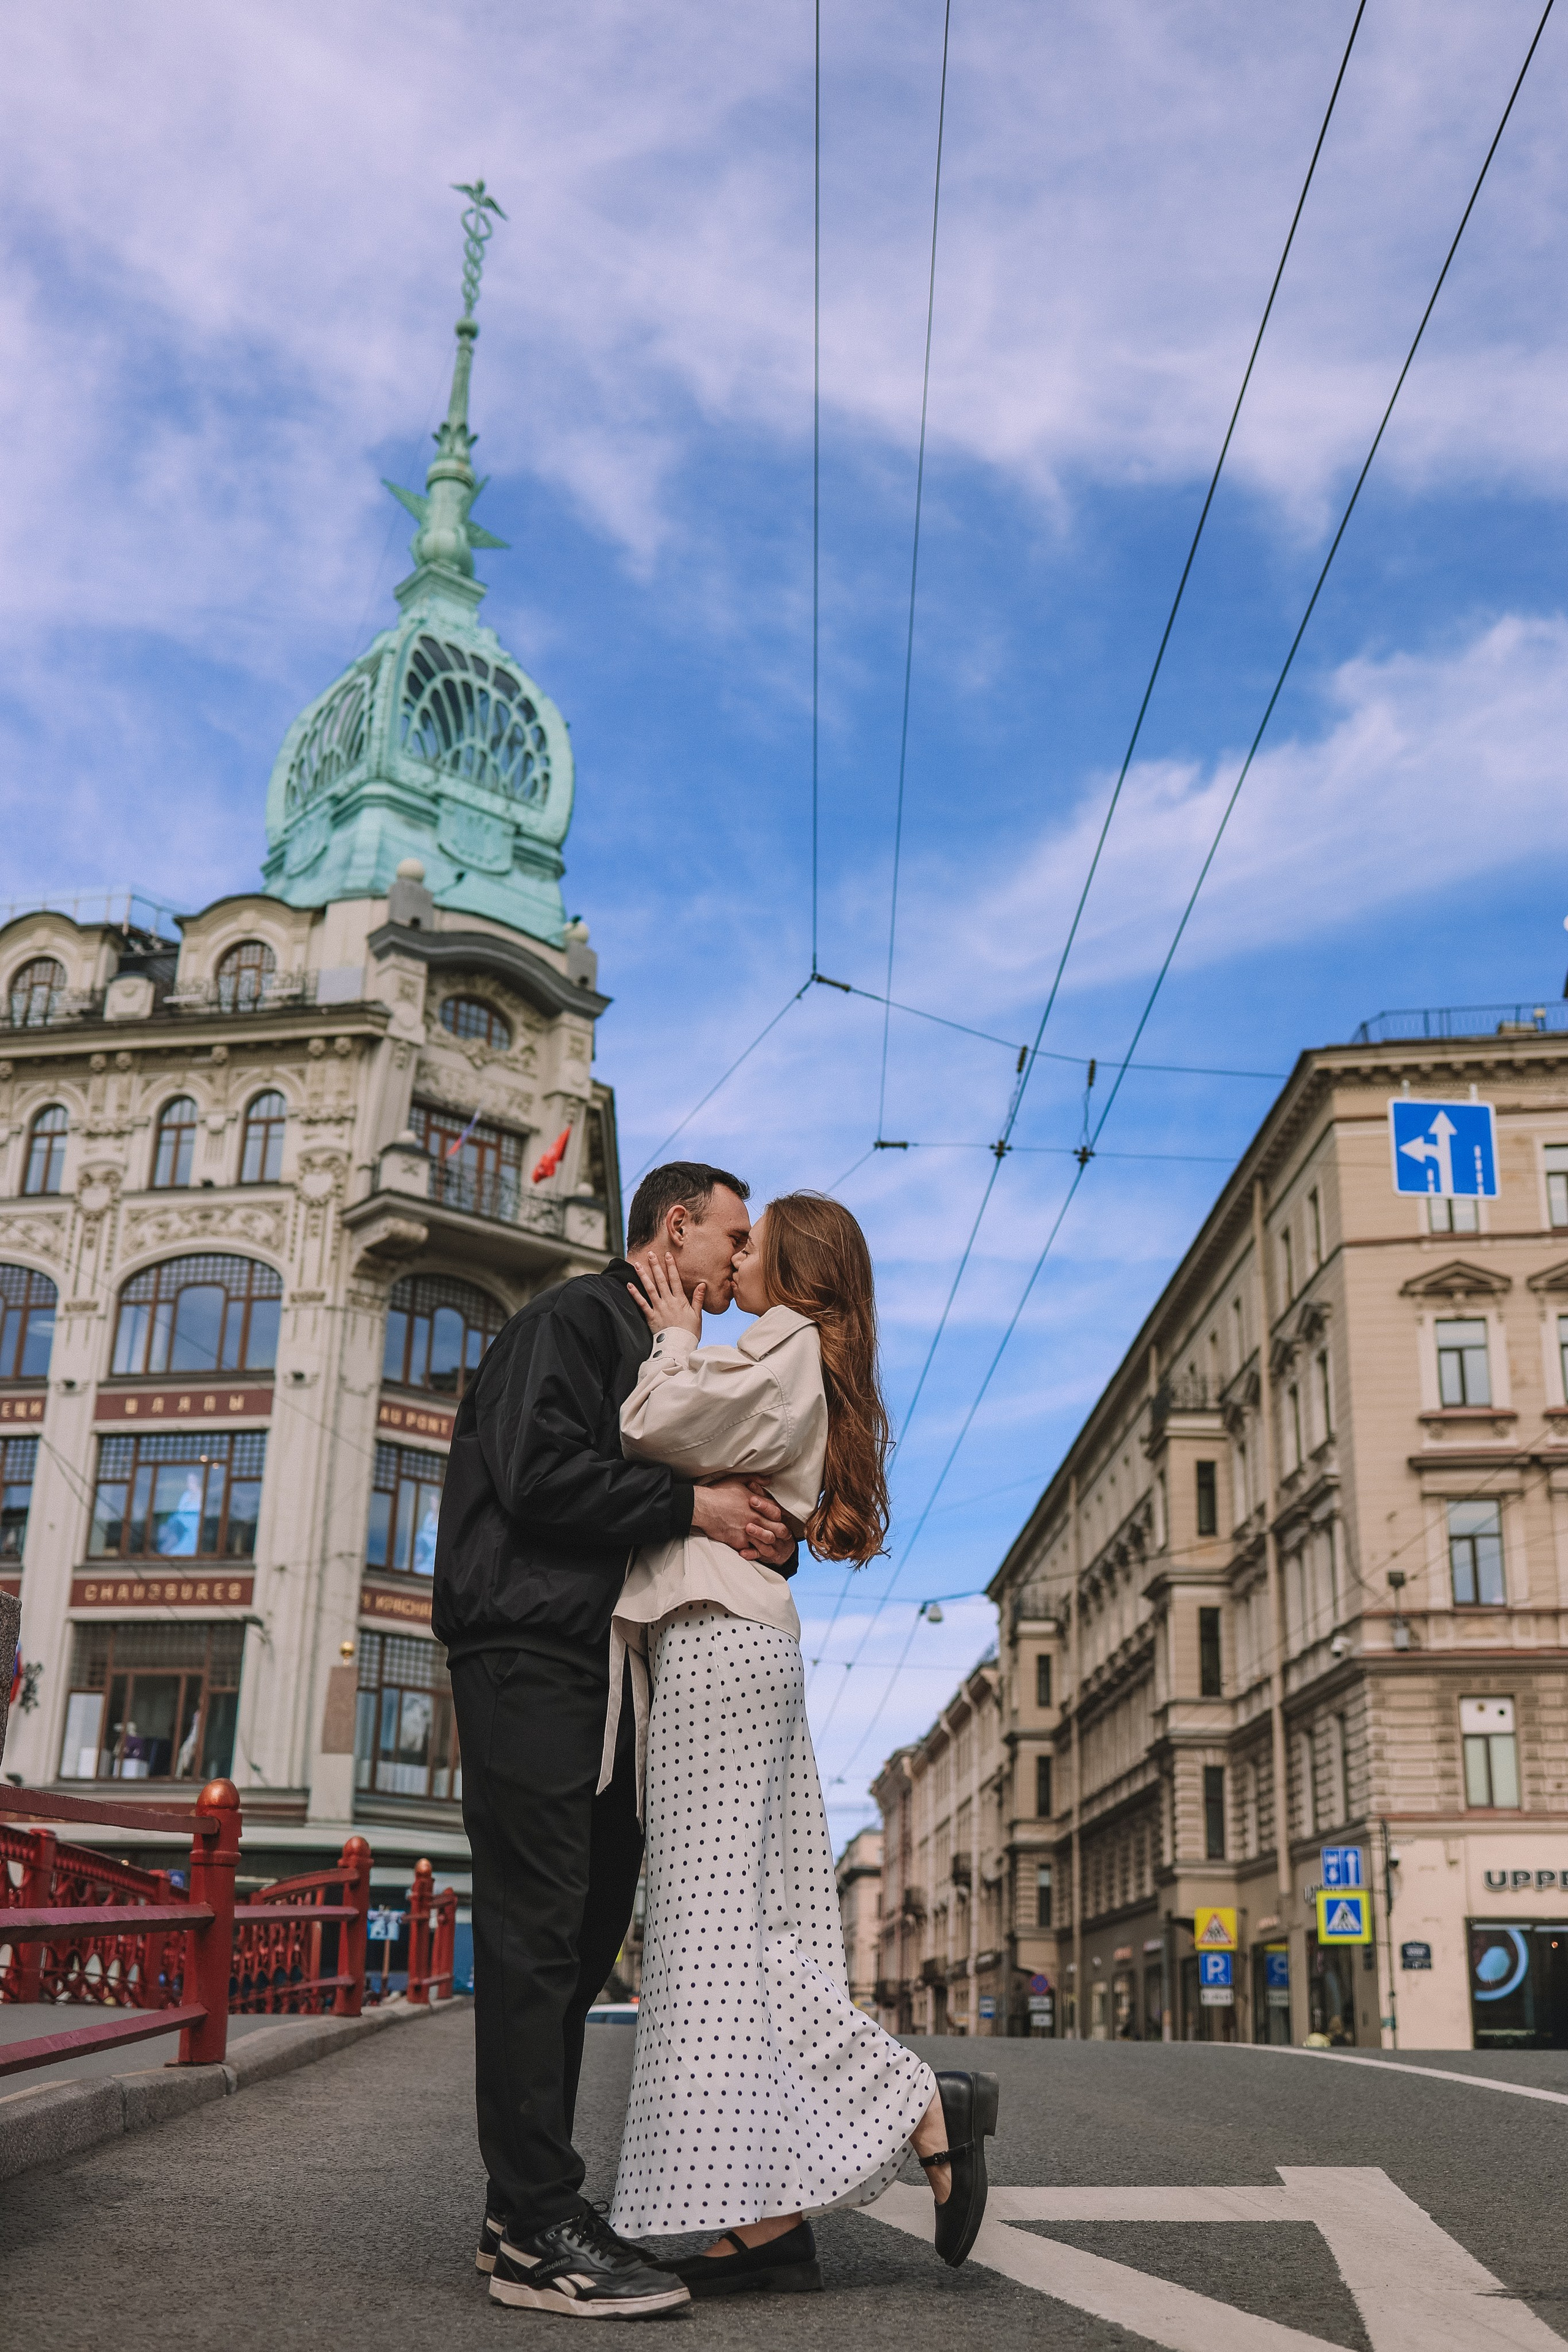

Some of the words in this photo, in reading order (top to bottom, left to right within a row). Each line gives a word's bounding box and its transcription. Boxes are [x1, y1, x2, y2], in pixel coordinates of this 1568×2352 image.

[380, 1406, 402, 1424] AU
[405, 1411, 449, 1434] PONT
[84, 1582, 242, 1601] CHAUSSURES
